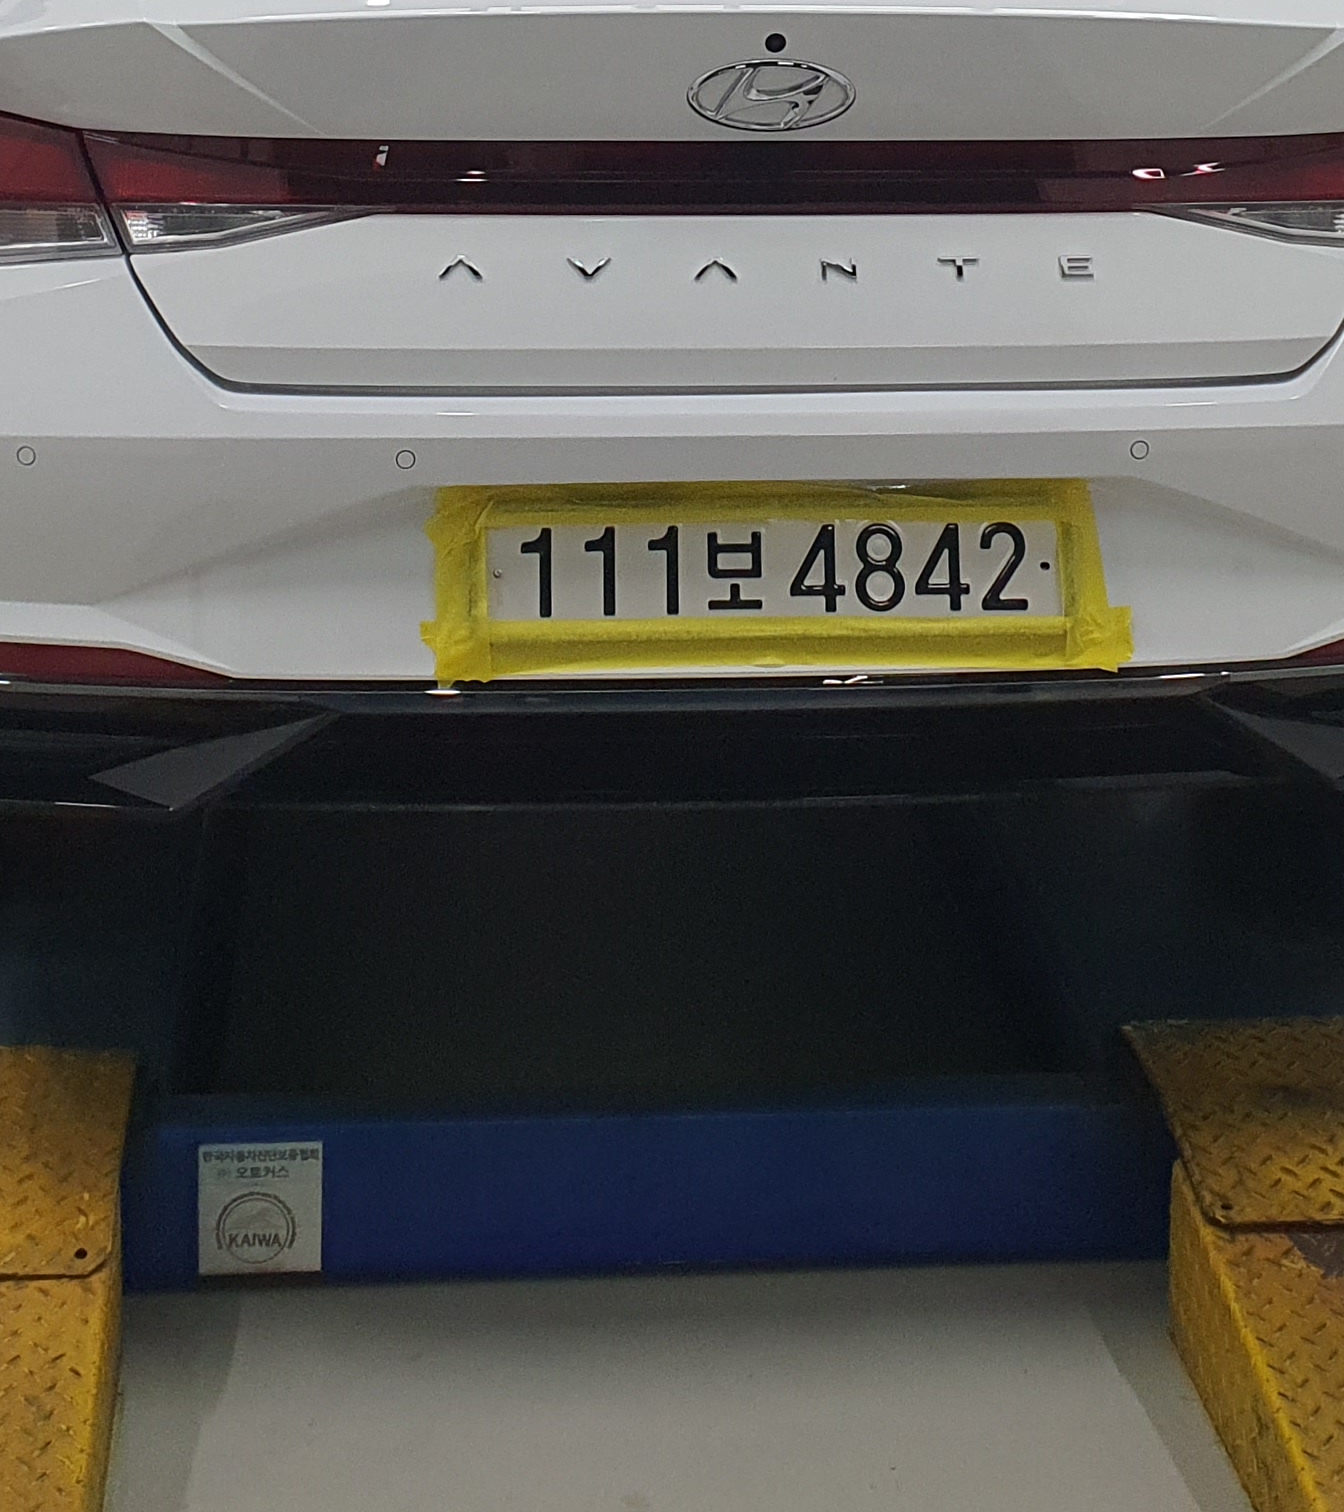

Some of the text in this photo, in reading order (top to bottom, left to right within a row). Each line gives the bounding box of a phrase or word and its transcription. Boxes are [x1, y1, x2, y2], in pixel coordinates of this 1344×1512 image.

[439, 254, 1095, 282] AVANTE
[520, 522, 1030, 618] 111보4842
[228, 1233, 283, 1248] KAIWA
